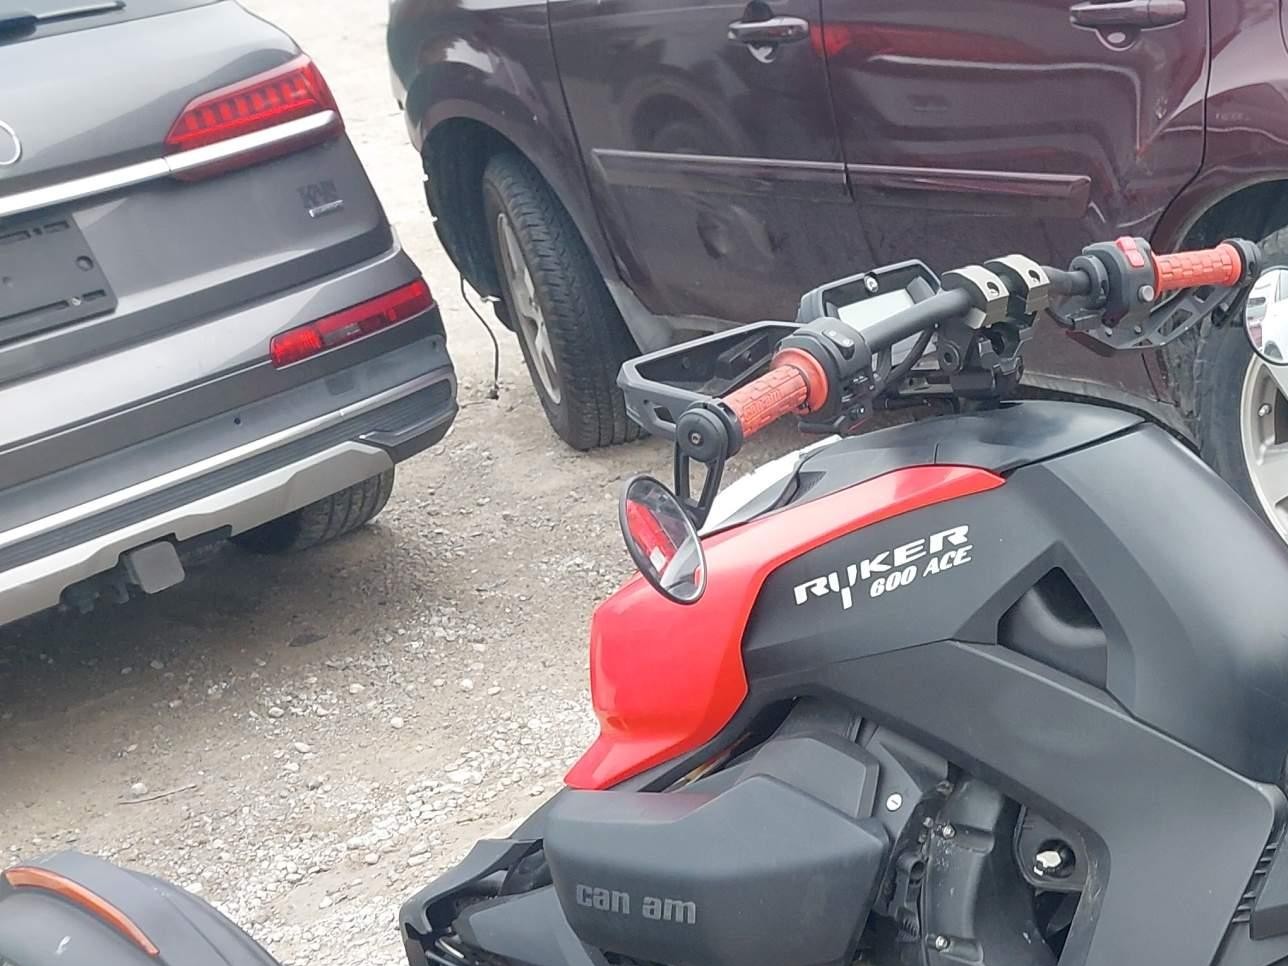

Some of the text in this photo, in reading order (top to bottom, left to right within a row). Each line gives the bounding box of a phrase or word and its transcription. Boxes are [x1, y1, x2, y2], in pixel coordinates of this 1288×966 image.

[794, 525, 969, 610] RYKER
[870, 544, 973, 598] 600 ACE
[576, 884, 696, 924] can am
